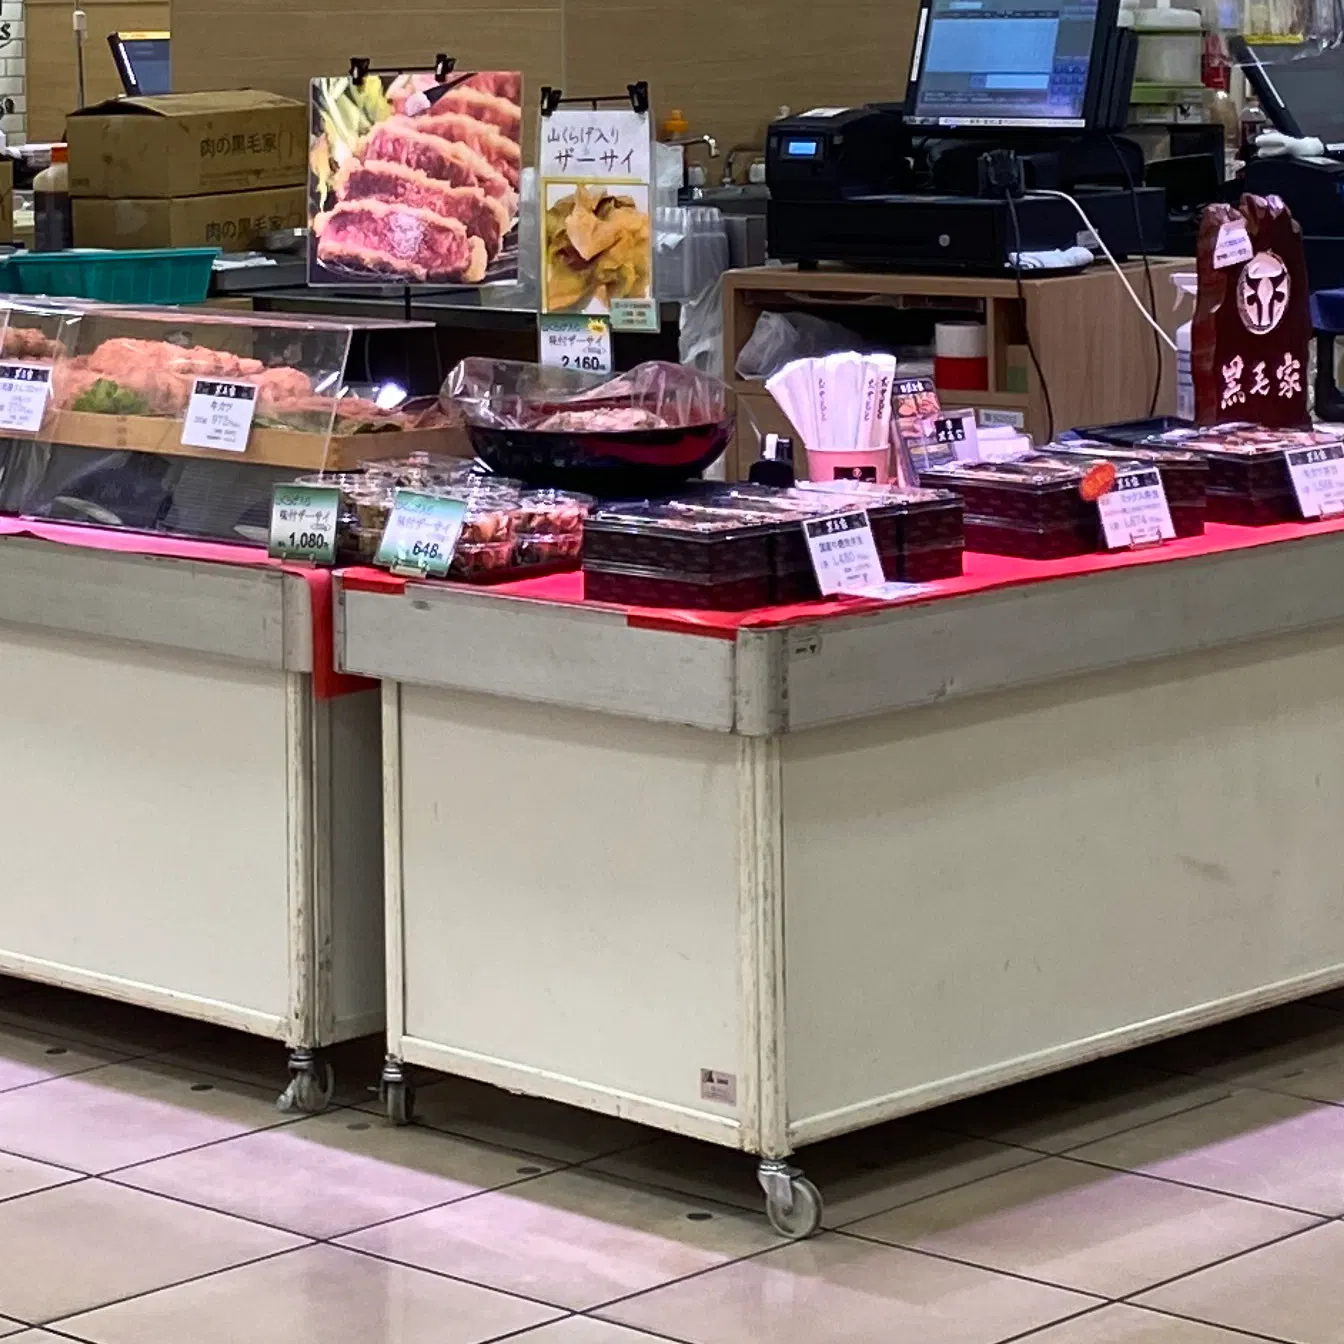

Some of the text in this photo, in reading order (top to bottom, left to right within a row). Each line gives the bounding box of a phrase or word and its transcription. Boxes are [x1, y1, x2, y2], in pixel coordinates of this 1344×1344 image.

[200, 132, 277, 158] 肉の黒毛家
[555, 148, 635, 173] ザーサイ
[1221, 352, 1302, 410] 黒毛家
